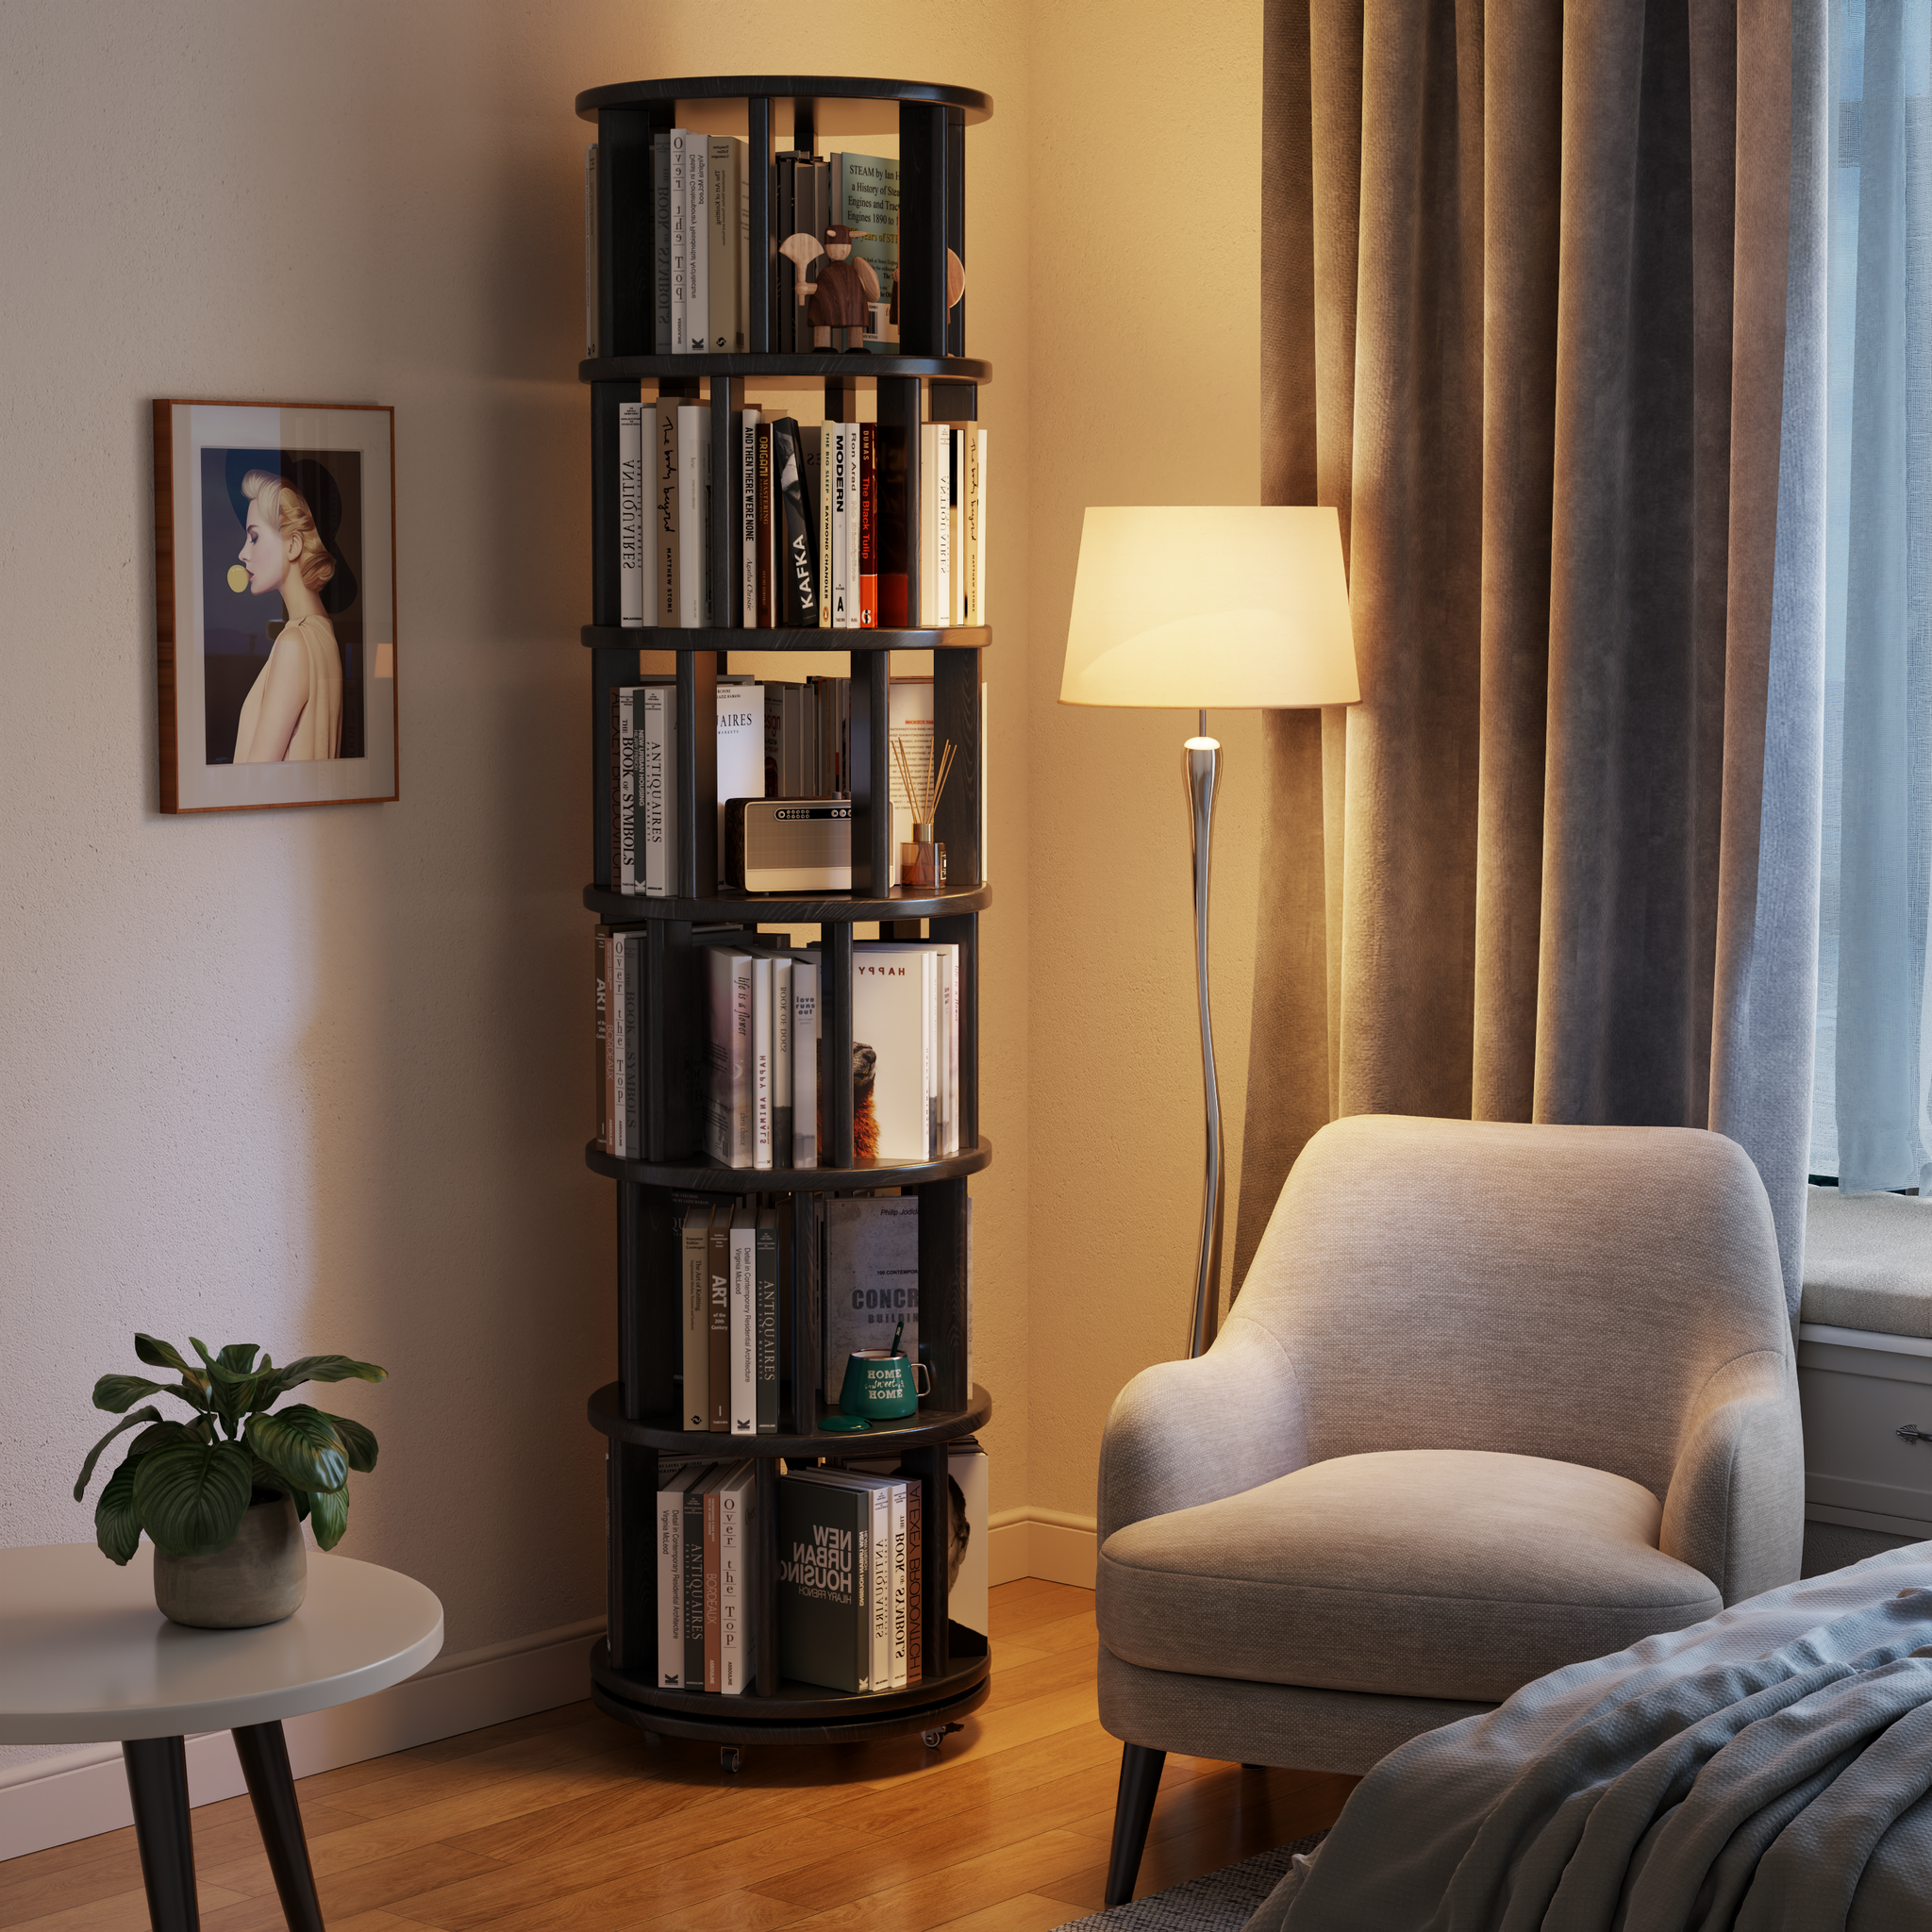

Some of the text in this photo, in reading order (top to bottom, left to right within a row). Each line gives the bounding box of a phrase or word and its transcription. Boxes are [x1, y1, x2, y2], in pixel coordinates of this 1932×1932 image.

[850, 164, 894, 180] STEAM by Ian
[848, 196, 884, 209] Engines and
[852, 182, 888, 196] a History of
[848, 211, 895, 225] Engines 1890 to
[860, 232, 886, 242] years of
[758, 437, 769, 477] ORIGAMI
[744, 427, 754, 542] AND THEN THERE WERE NONE
[836, 435, 844, 513] MODERN
[861, 476, 871, 559] The Black Tulip
[745, 558, 754, 583] Agatha
[792, 534, 814, 610] KAFKA
[622, 737, 633, 773] BOOK
[623, 781, 629, 791] OF
[650, 741, 661, 844] ANTIQUAIRES
[622, 793, 635, 866] SYMBOLS
[596, 977, 606, 1011] ART
[733, 976, 751, 991] life
[733, 1008, 751, 1037] flower
[625, 991, 637, 1129] BOOK SYMBOLS
[740, 1112, 749, 1127] chris
[734, 1247, 742, 1270] Virginia
[694, 1290, 703, 1311] Knitting
[711, 1274, 727, 1308] ART
[742, 1273, 752, 1313] Contemporary
[852, 1288, 919, 1310] CONCR
[762, 1280, 775, 1382] ANTIQUAIRES
[867, 1369, 901, 1379] HOME
[874, 1378, 897, 1389] sweet
[868, 1389, 904, 1400] HOME
[661, 1509, 670, 1531] Virginia
[724, 1498, 735, 1646] Over the Top
[689, 1543, 703, 1641] ANTIQUAIRES
[707, 1573, 717, 1624] BORDEAUX
